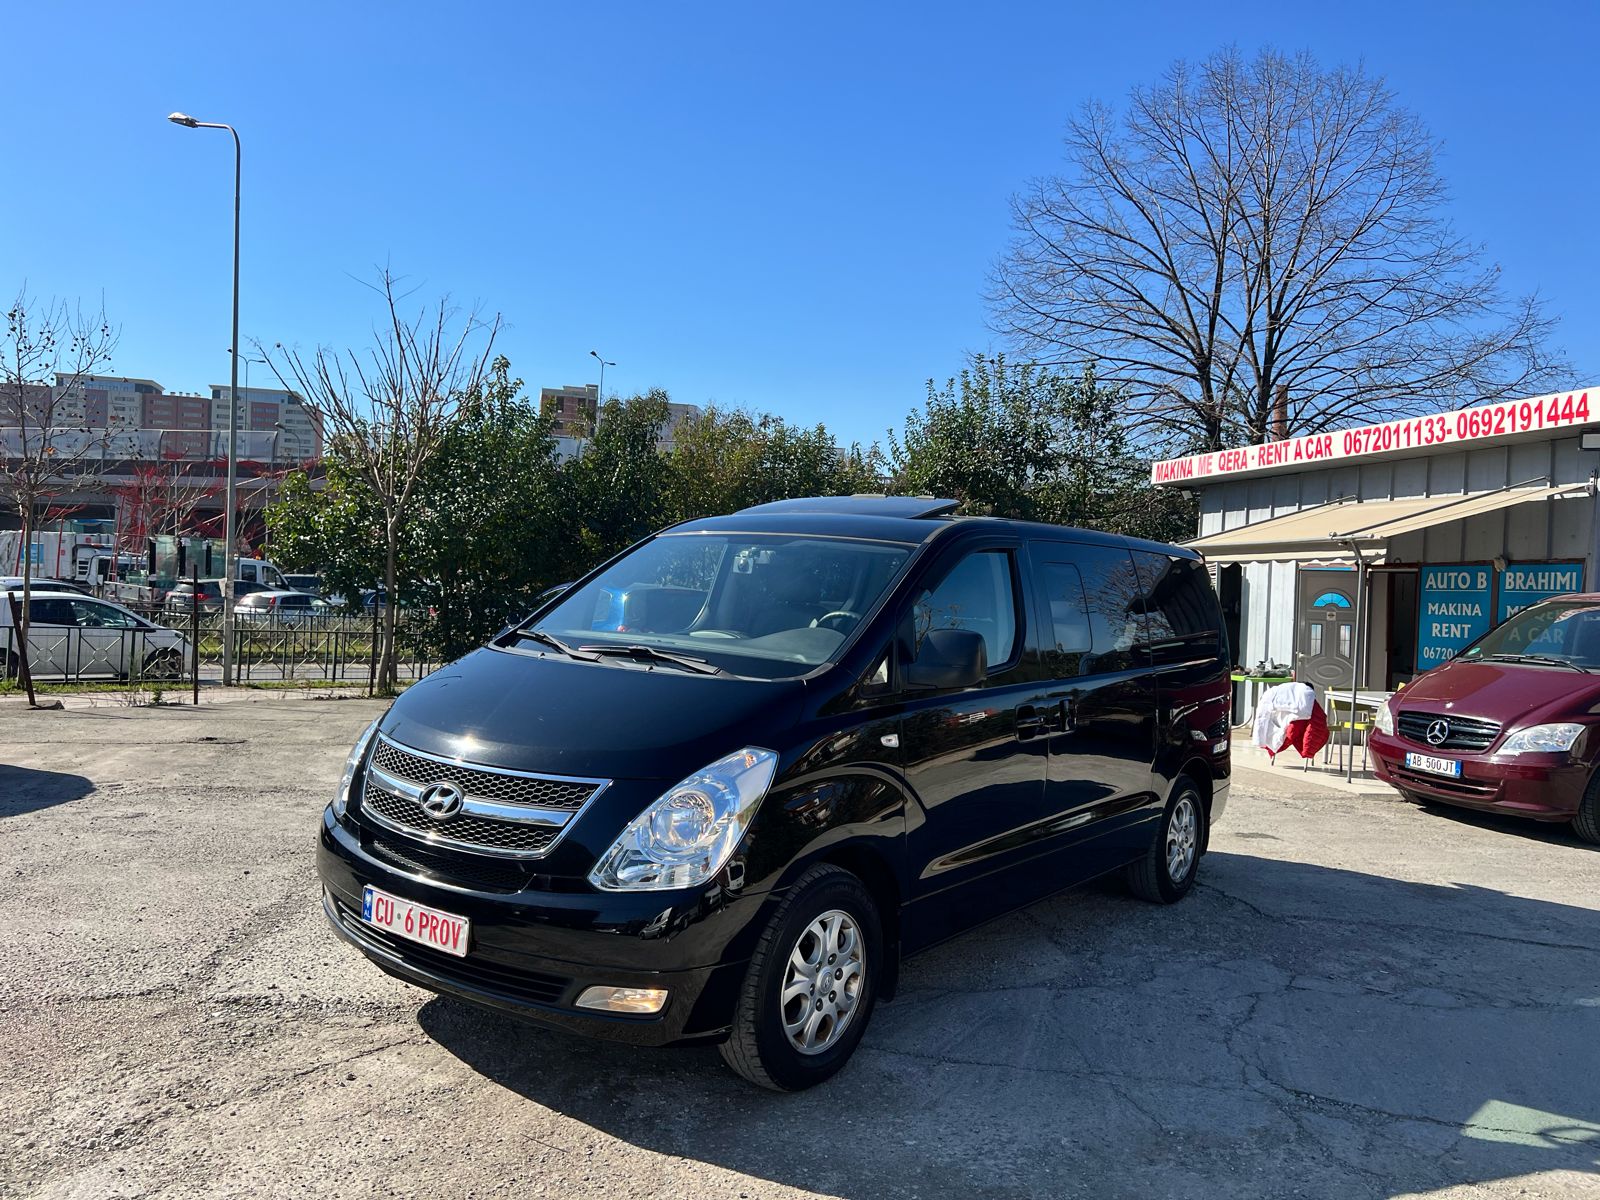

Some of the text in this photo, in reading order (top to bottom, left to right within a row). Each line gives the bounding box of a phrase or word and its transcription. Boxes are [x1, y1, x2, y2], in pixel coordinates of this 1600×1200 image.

[1155, 458, 1193, 482] MAKINA
[1197, 455, 1213, 476] ME
[1218, 450, 1248, 472] QERA
[1258, 441, 1291, 466] RENT
[1294, 439, 1303, 461] A
[1305, 435, 1333, 460] CAR
[1456, 392, 1590, 440] 0692191444
[1425, 572, 1487, 589] AUTO B
[1505, 572, 1577, 590] BRAHIMI
[1428, 603, 1482, 616] MAKINA
[1506, 605, 1527, 618] M
[1432, 623, 1471, 638] RENT
[1508, 627, 1564, 644] A CAR
[1412, 755, 1454, 773] AB 500 JT
[375, 897, 394, 926] CU
[405, 906, 414, 934] 6
[418, 911, 462, 950] PROV
